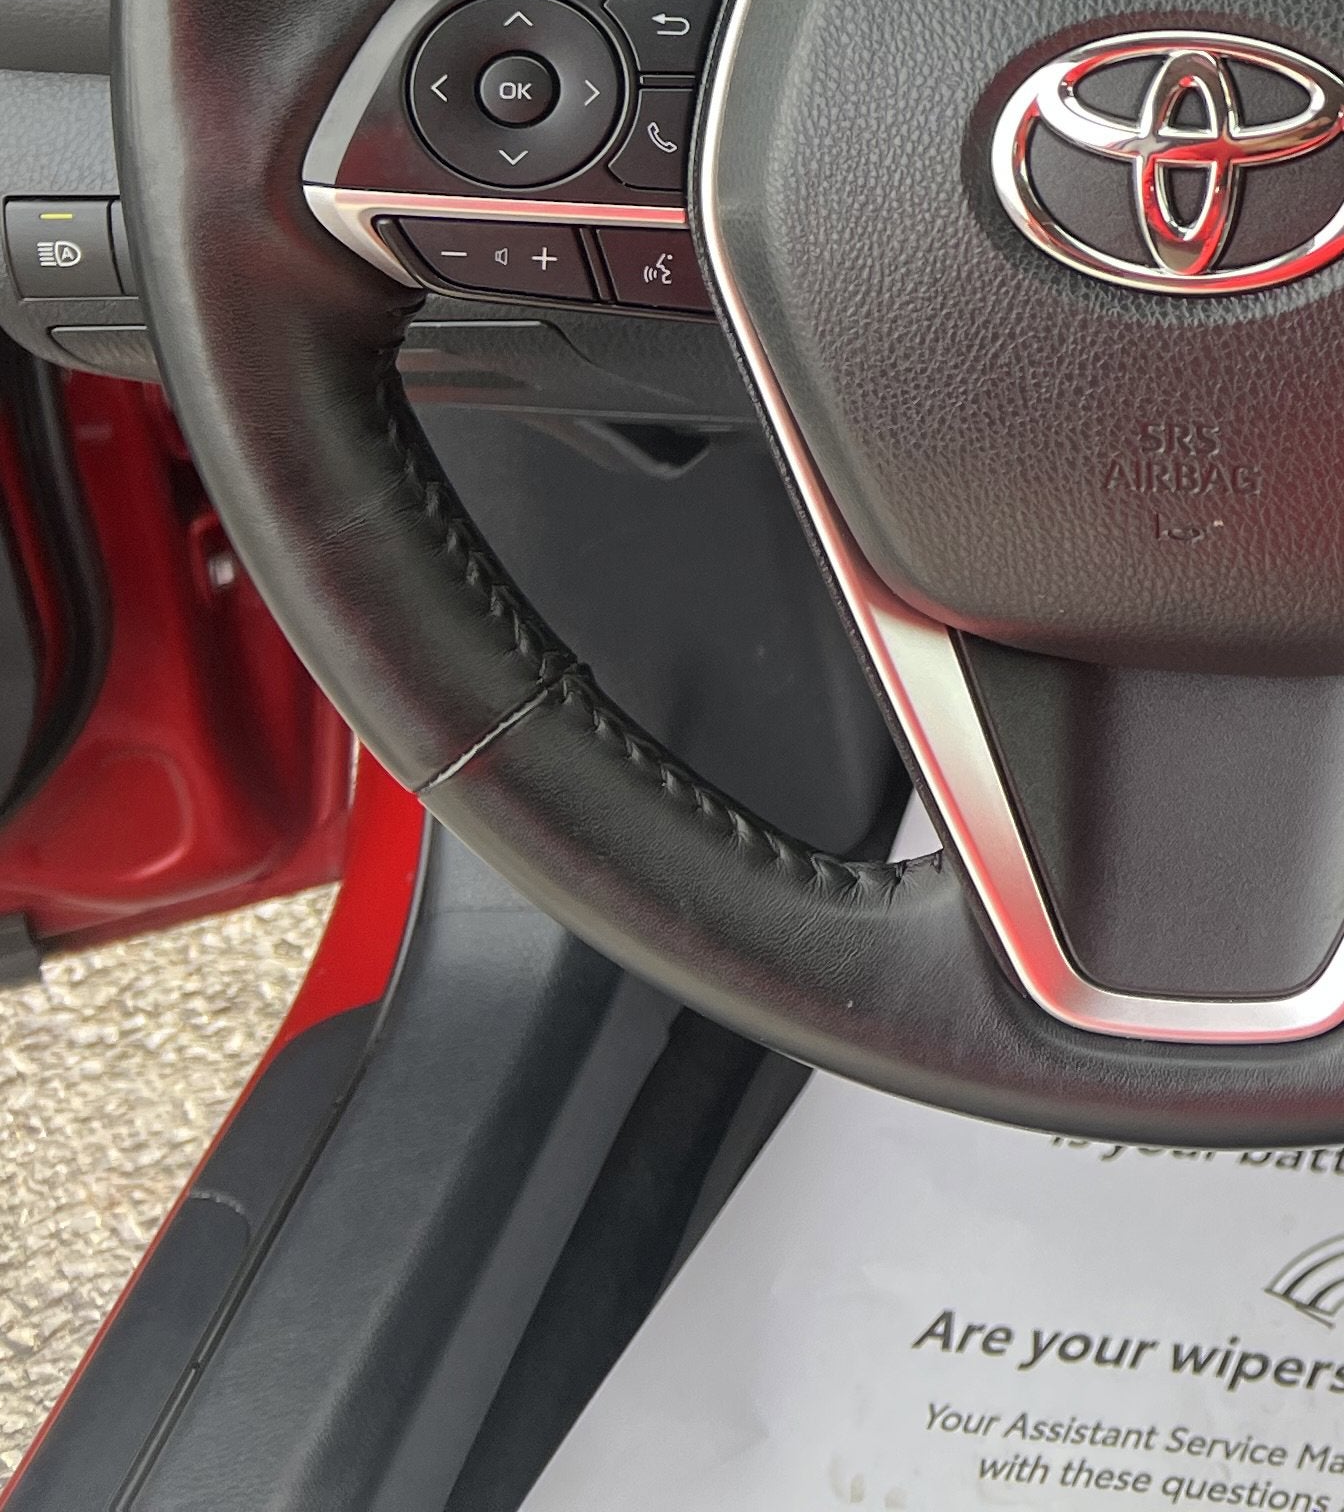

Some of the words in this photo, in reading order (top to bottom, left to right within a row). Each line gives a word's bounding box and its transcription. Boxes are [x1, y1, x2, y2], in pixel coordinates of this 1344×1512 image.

[499, 81, 533, 101] OK
[1141, 422, 1221, 457] SRS
[1104, 459, 1261, 495] AIRBAG
[911, 1309, 1014, 1359] Are
[1018, 1328, 1160, 1372] your
[925, 1403, 1001, 1437] Your
[1002, 1411, 1160, 1452] Assistant
[1164, 1426, 1289, 1467] Service
[978, 1454, 1049, 1485] with
[1059, 1459, 1152, 1493] these
[1160, 1474, 1331, 1512] questions
